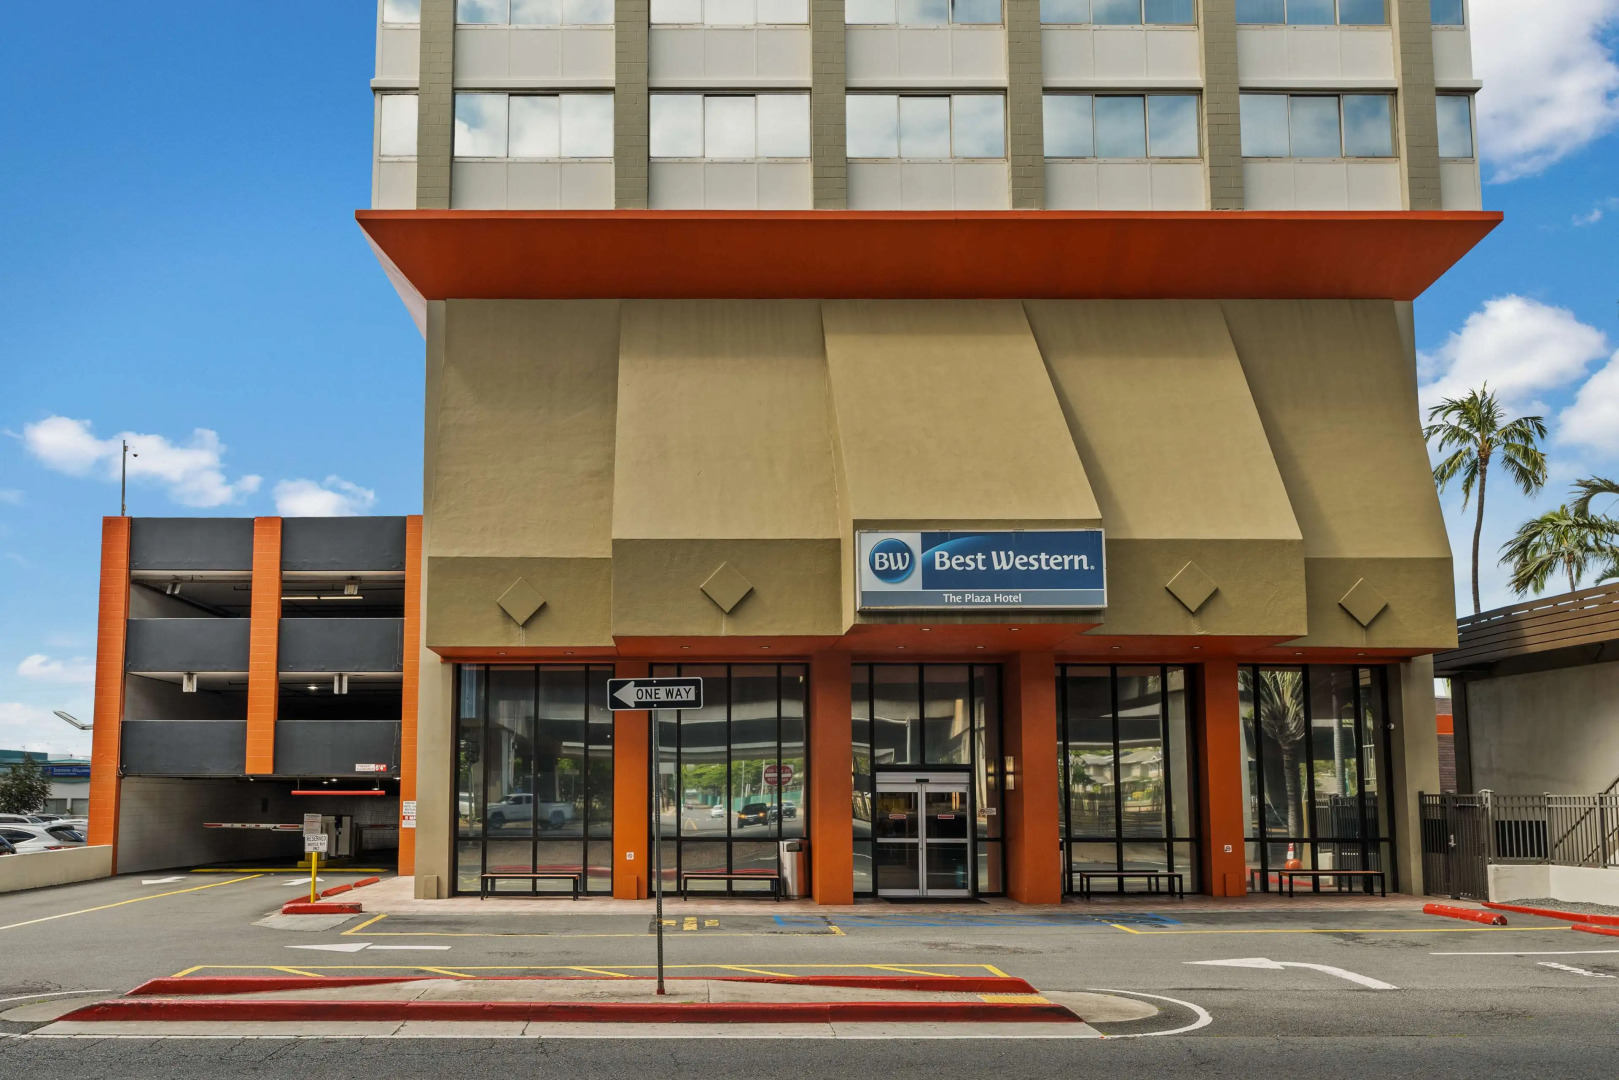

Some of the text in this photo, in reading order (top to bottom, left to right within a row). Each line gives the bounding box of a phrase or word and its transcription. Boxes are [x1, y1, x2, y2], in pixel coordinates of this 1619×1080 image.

[874, 552, 910, 571] BW
[934, 551, 987, 571] Best
[942, 593, 1022, 603] The Plaza Hotel
[636, 687, 692, 700] ONE WAY
